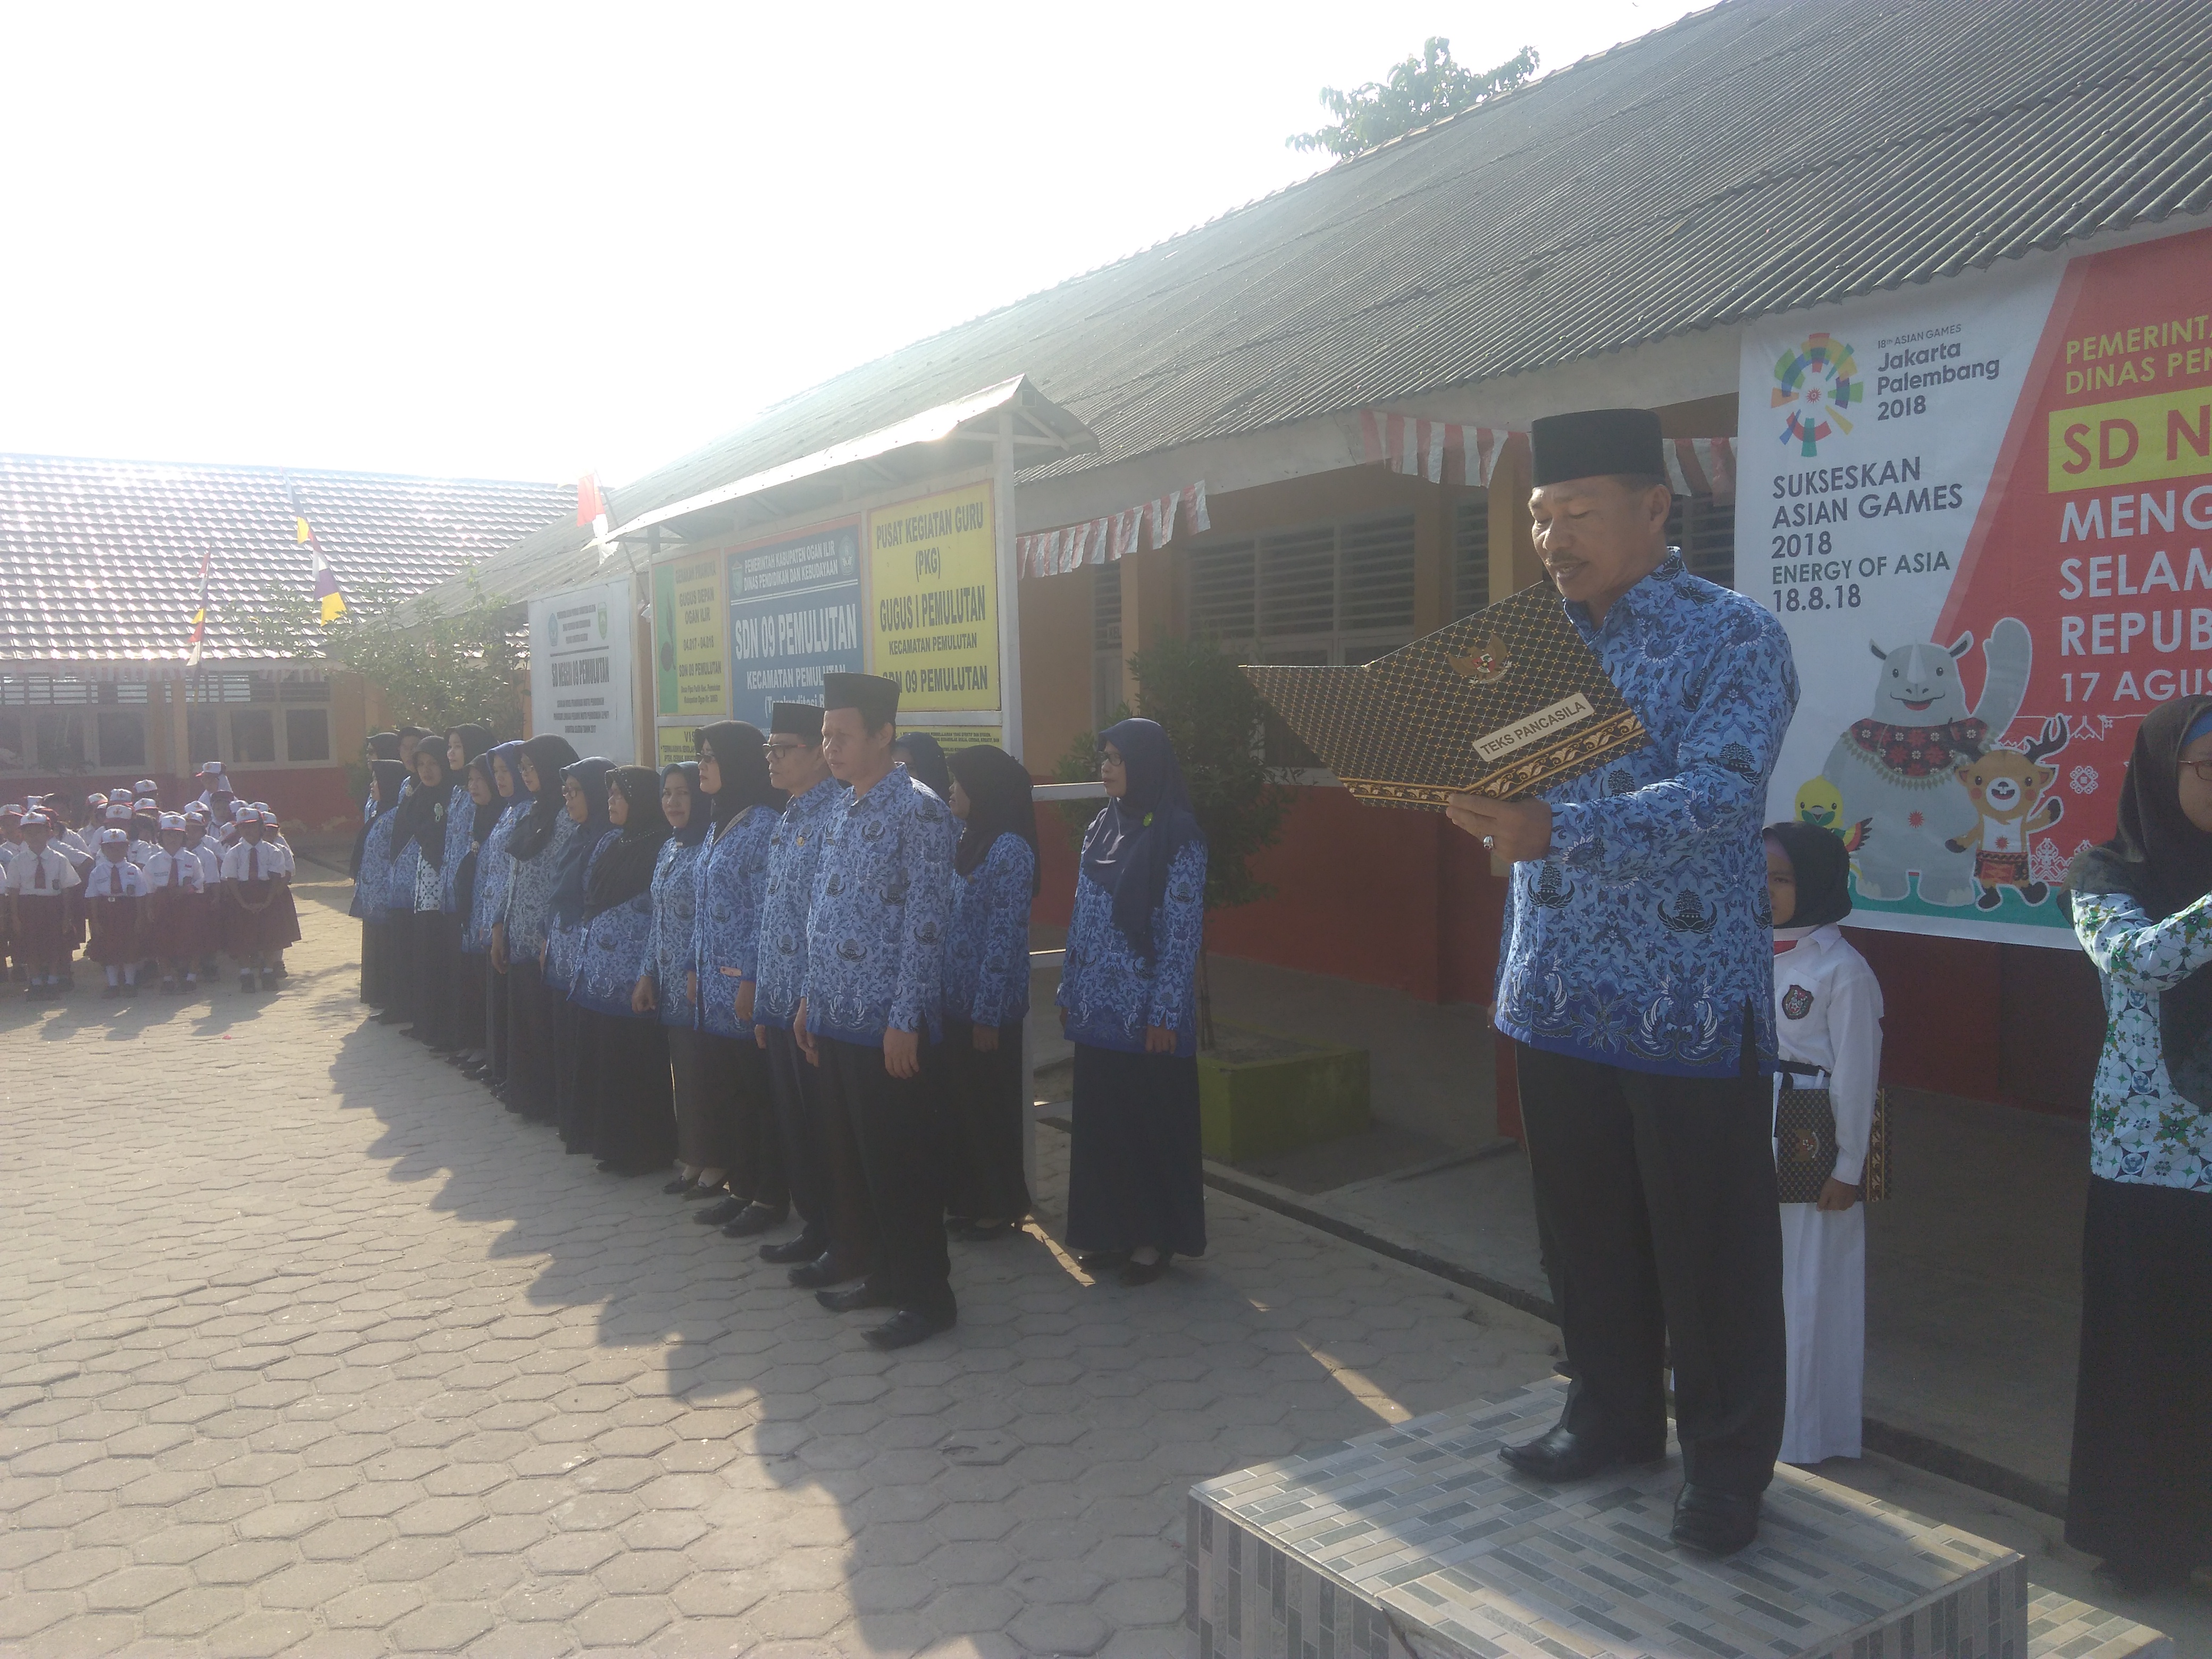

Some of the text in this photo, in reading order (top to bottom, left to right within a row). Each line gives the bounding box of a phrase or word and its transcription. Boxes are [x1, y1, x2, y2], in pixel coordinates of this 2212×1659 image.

[1878, 324, 1962, 349] 18th ASIAN GAMES
[2066, 314, 2212, 364] PEMERINT
[1878, 342, 1960, 372] Jakarta
[1878, 359, 2000, 395] Palembang
[2066, 357, 2156, 395] DINAS
[1878, 395, 1926, 421] 2018
[2062, 418, 2139, 475] SD
[1772, 456, 1920, 499] SUKSESKAN
[1772, 483, 1963, 529] ASIAN GAMES
[2059, 485, 2212, 543] MENG
[876, 501, 983, 549] PUSAT KEGIATAN GURU
[744, 540, 835, 574] PEMERINTAH KABUPATEN OGAN ILIR
[1771, 531, 1832, 559] 2018
[744, 559, 838, 591] DINAS PENDIDIKAN DAN KEBUDAYAAN
[916, 547, 941, 583] (PKG)
[1772, 551, 1950, 585] ENERGY OF ASIA
[680, 586, 714, 607] GUGUS DEPAN
[879, 585, 985, 632] GUGUS I PEMULUTAN
[1773, 583, 1861, 612] 18.8.18
[685, 607, 710, 624] OGAN ILIR
[735, 604, 857, 660] SDN 09 PEMULUTAN
[2061, 608, 2212, 656] REPUB
[889, 633, 977, 655] KECAMATAN PEMULUTAN
[579, 656, 609, 685] PEMULUTAN
[679, 661, 722, 677] SDN 09 PEMULUTAN
[747, 668, 794, 690] KECAMATAN
[906, 670, 917, 693] 09
[920, 666, 988, 692] PEMULUTAN
[2061, 668, 2212, 702] 17 AGU
[1480, 701, 1586, 755] TEKS PANCASILA
